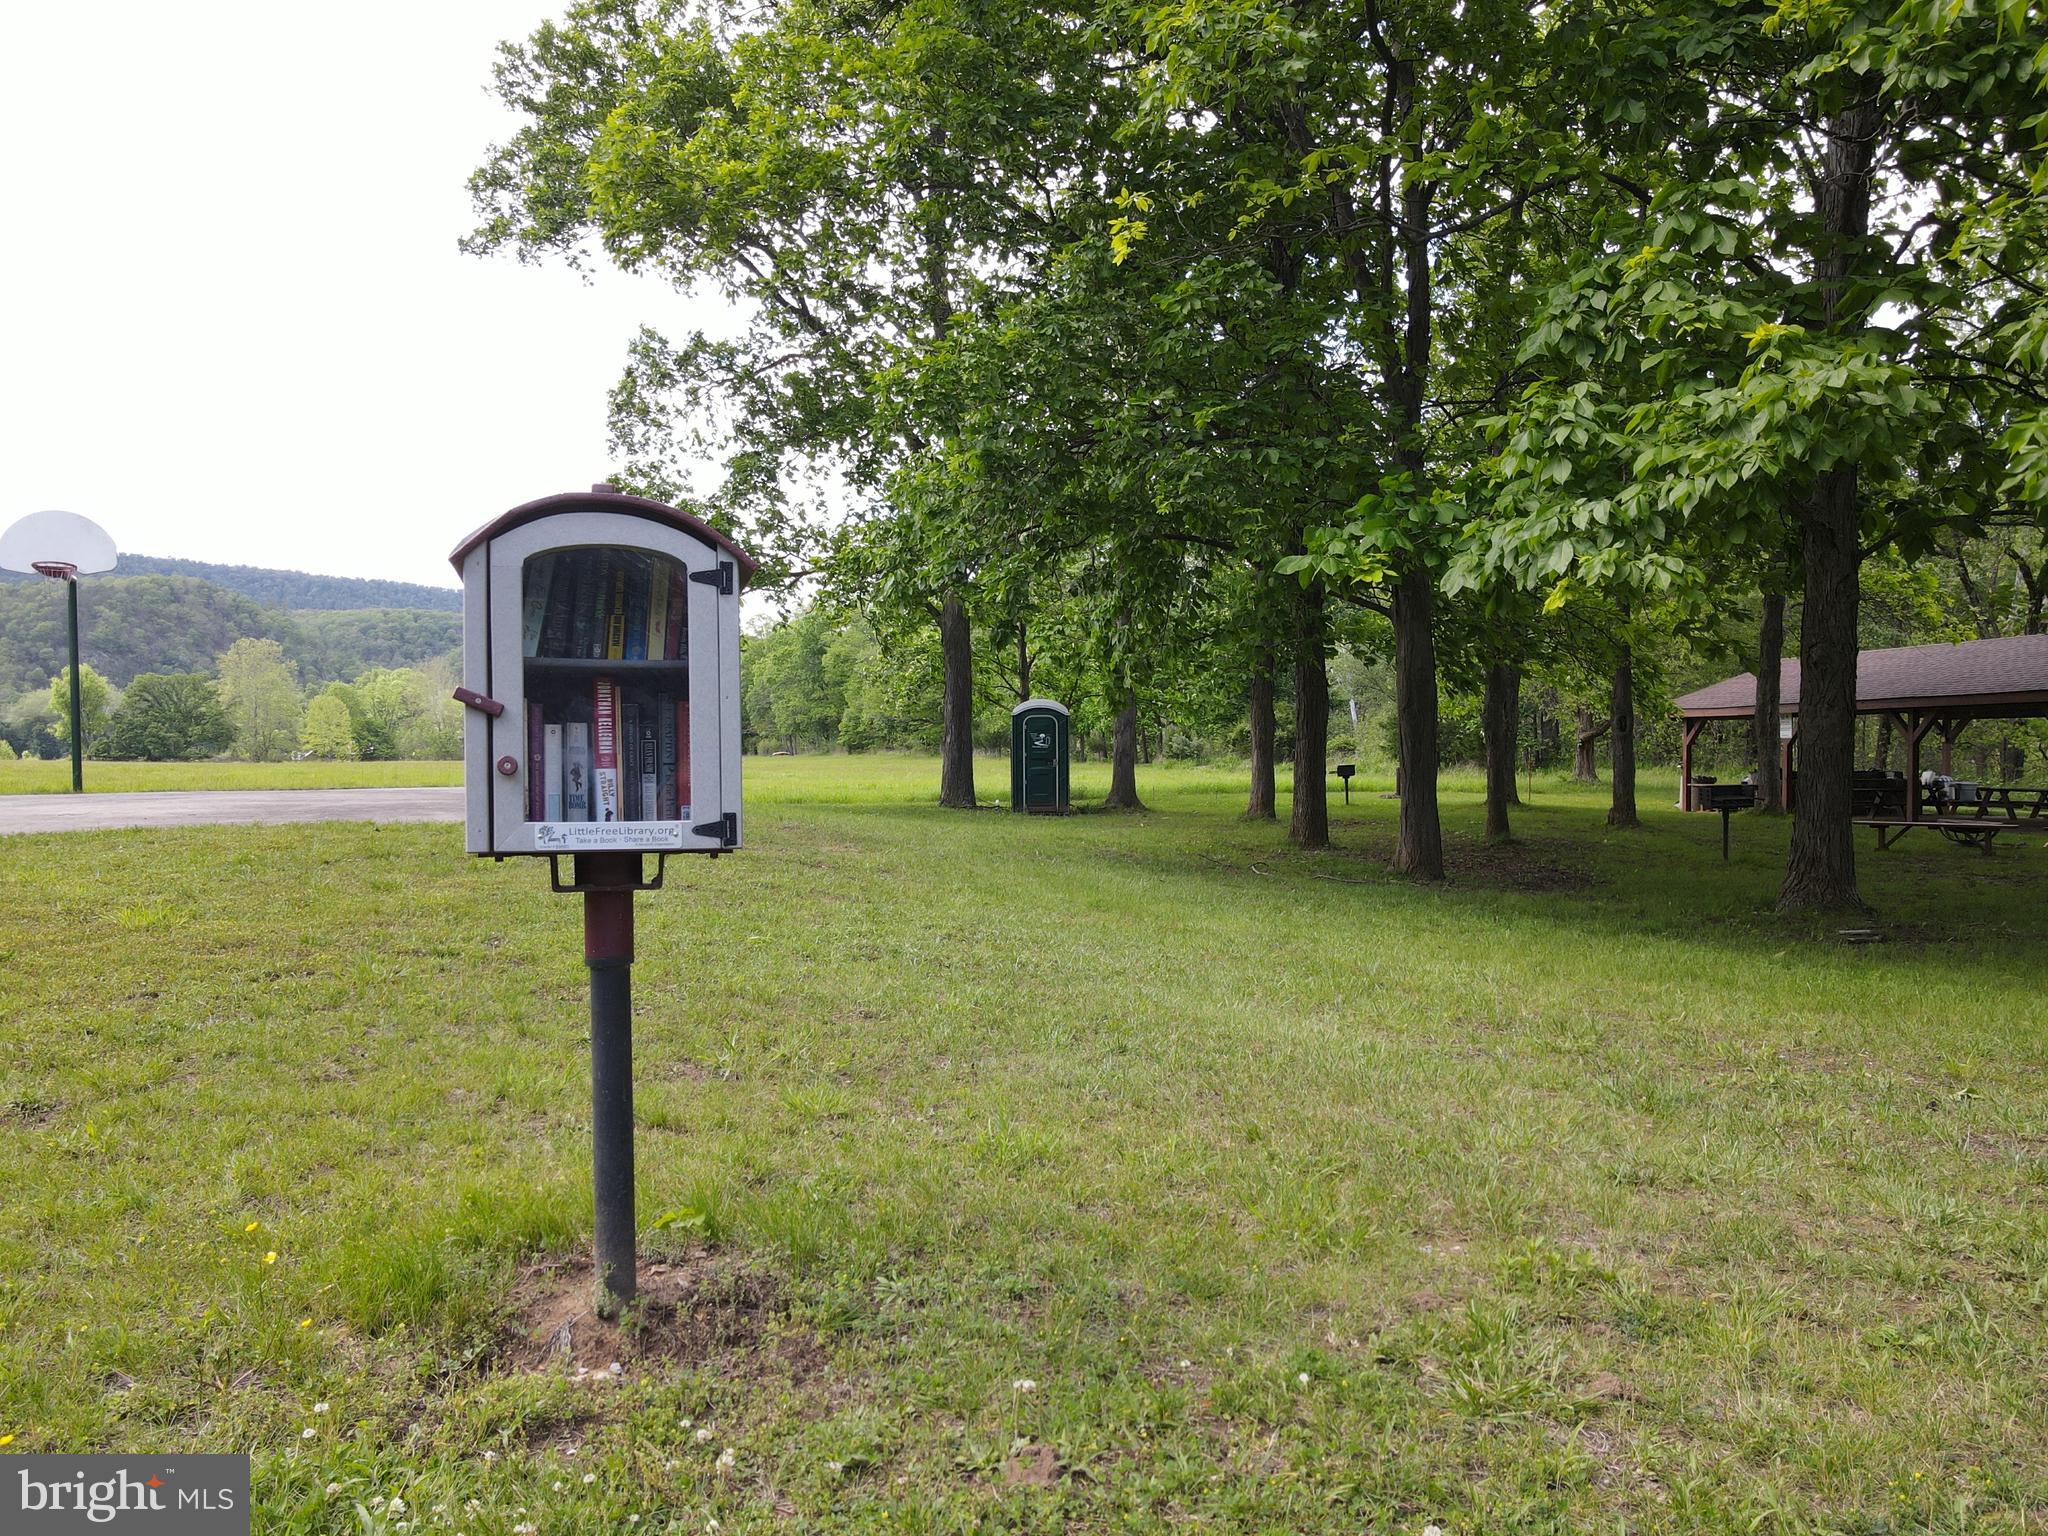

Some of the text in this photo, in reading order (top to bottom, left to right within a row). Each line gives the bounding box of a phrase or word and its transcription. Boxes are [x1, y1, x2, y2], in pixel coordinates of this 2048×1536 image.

[598, 682, 613, 753] JONATHAN KELLERMAN
[600, 771, 610, 806] STRAIGHT
[607, 778, 616, 797] BILLY
[569, 827, 674, 836] LittleFreeLibrary.org
